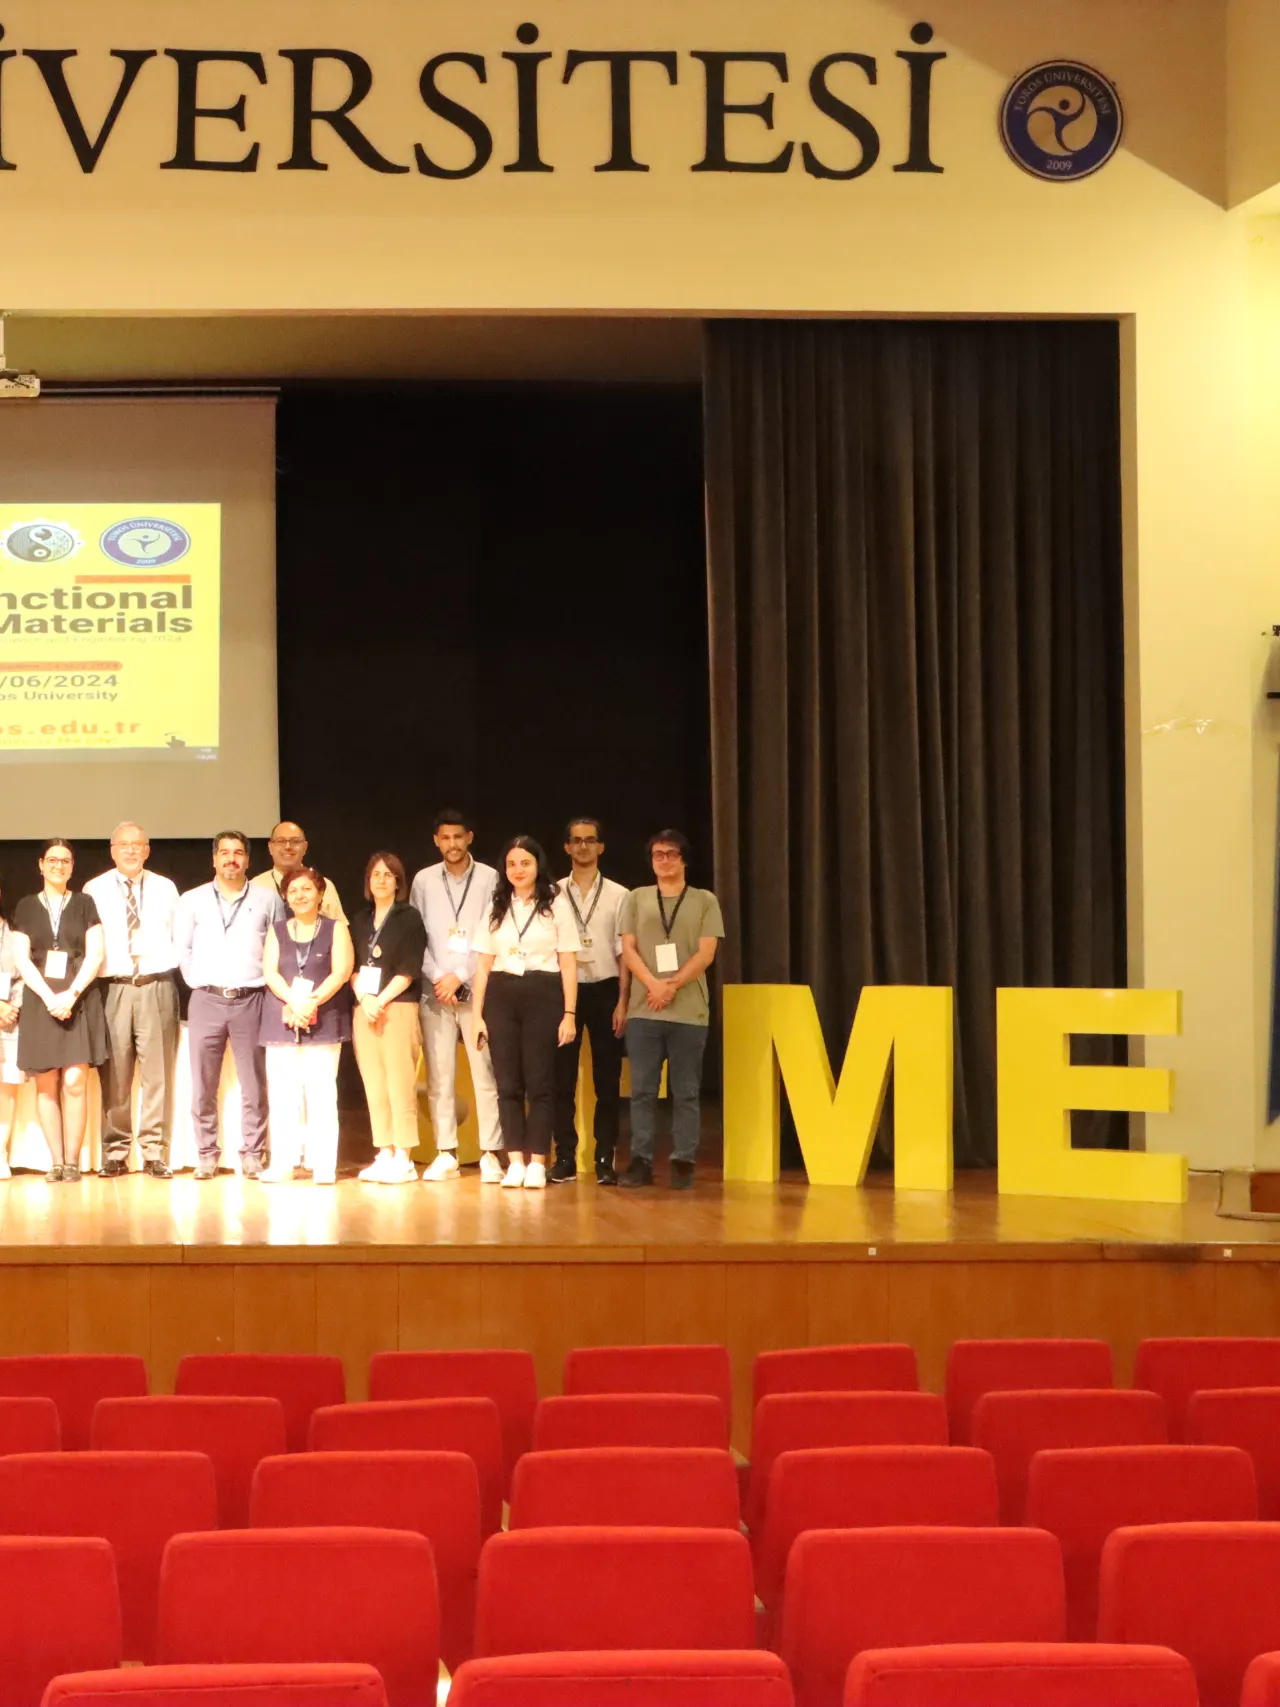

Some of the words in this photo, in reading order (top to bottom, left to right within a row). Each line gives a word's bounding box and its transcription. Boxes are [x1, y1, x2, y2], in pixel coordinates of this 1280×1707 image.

[1013, 77, 1043, 111] TOROS
[1046, 160, 1072, 171] 2009
[24, 689, 119, 704] University
